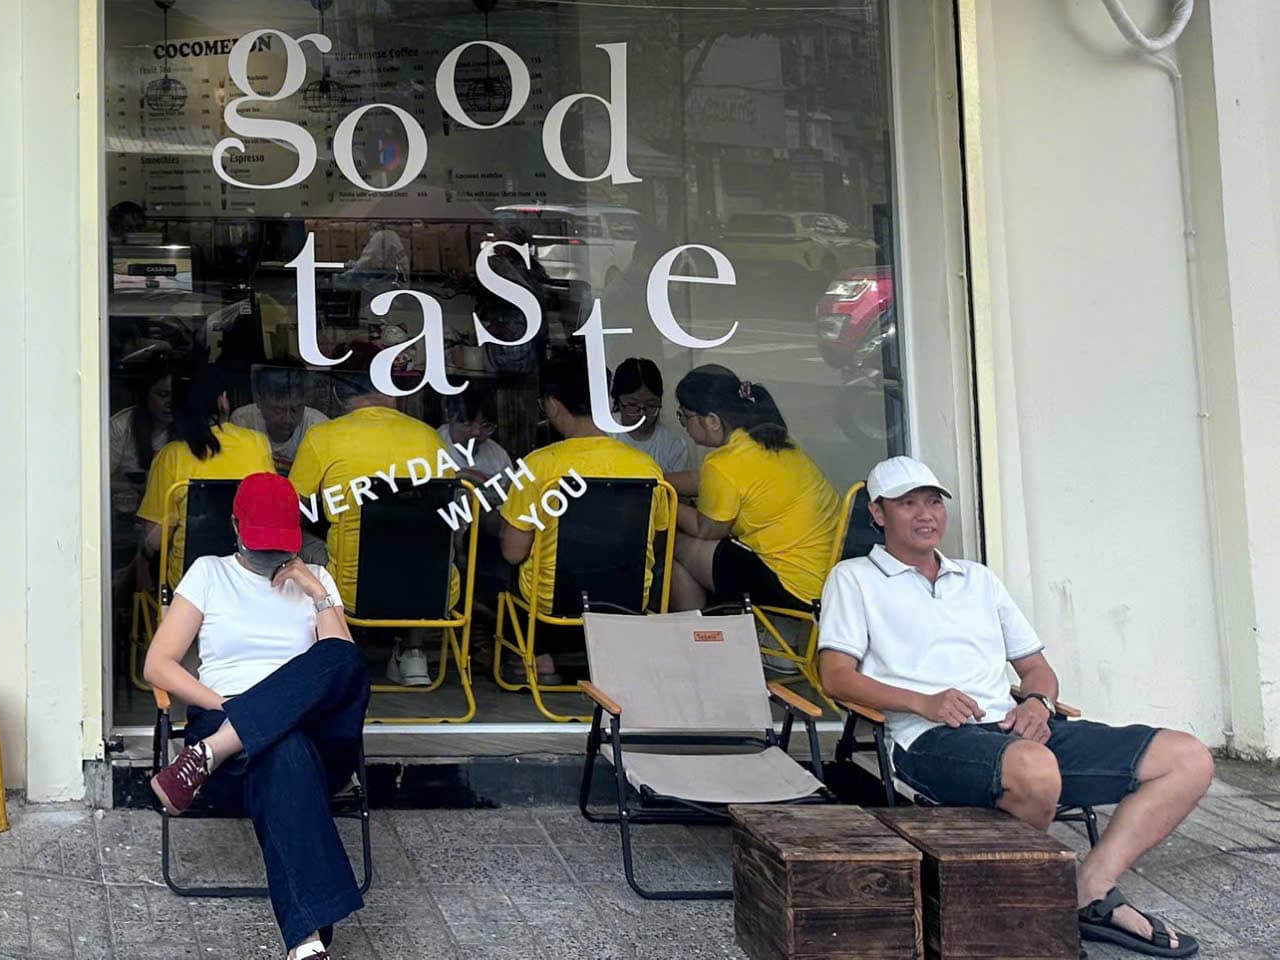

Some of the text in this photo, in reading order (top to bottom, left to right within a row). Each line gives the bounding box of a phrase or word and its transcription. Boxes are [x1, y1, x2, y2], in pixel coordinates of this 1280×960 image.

[211, 28, 642, 192] good
[230, 153, 265, 164] Espresso
[284, 231, 739, 435] taste
[298, 438, 588, 533] VERYDAY WITH YOU
